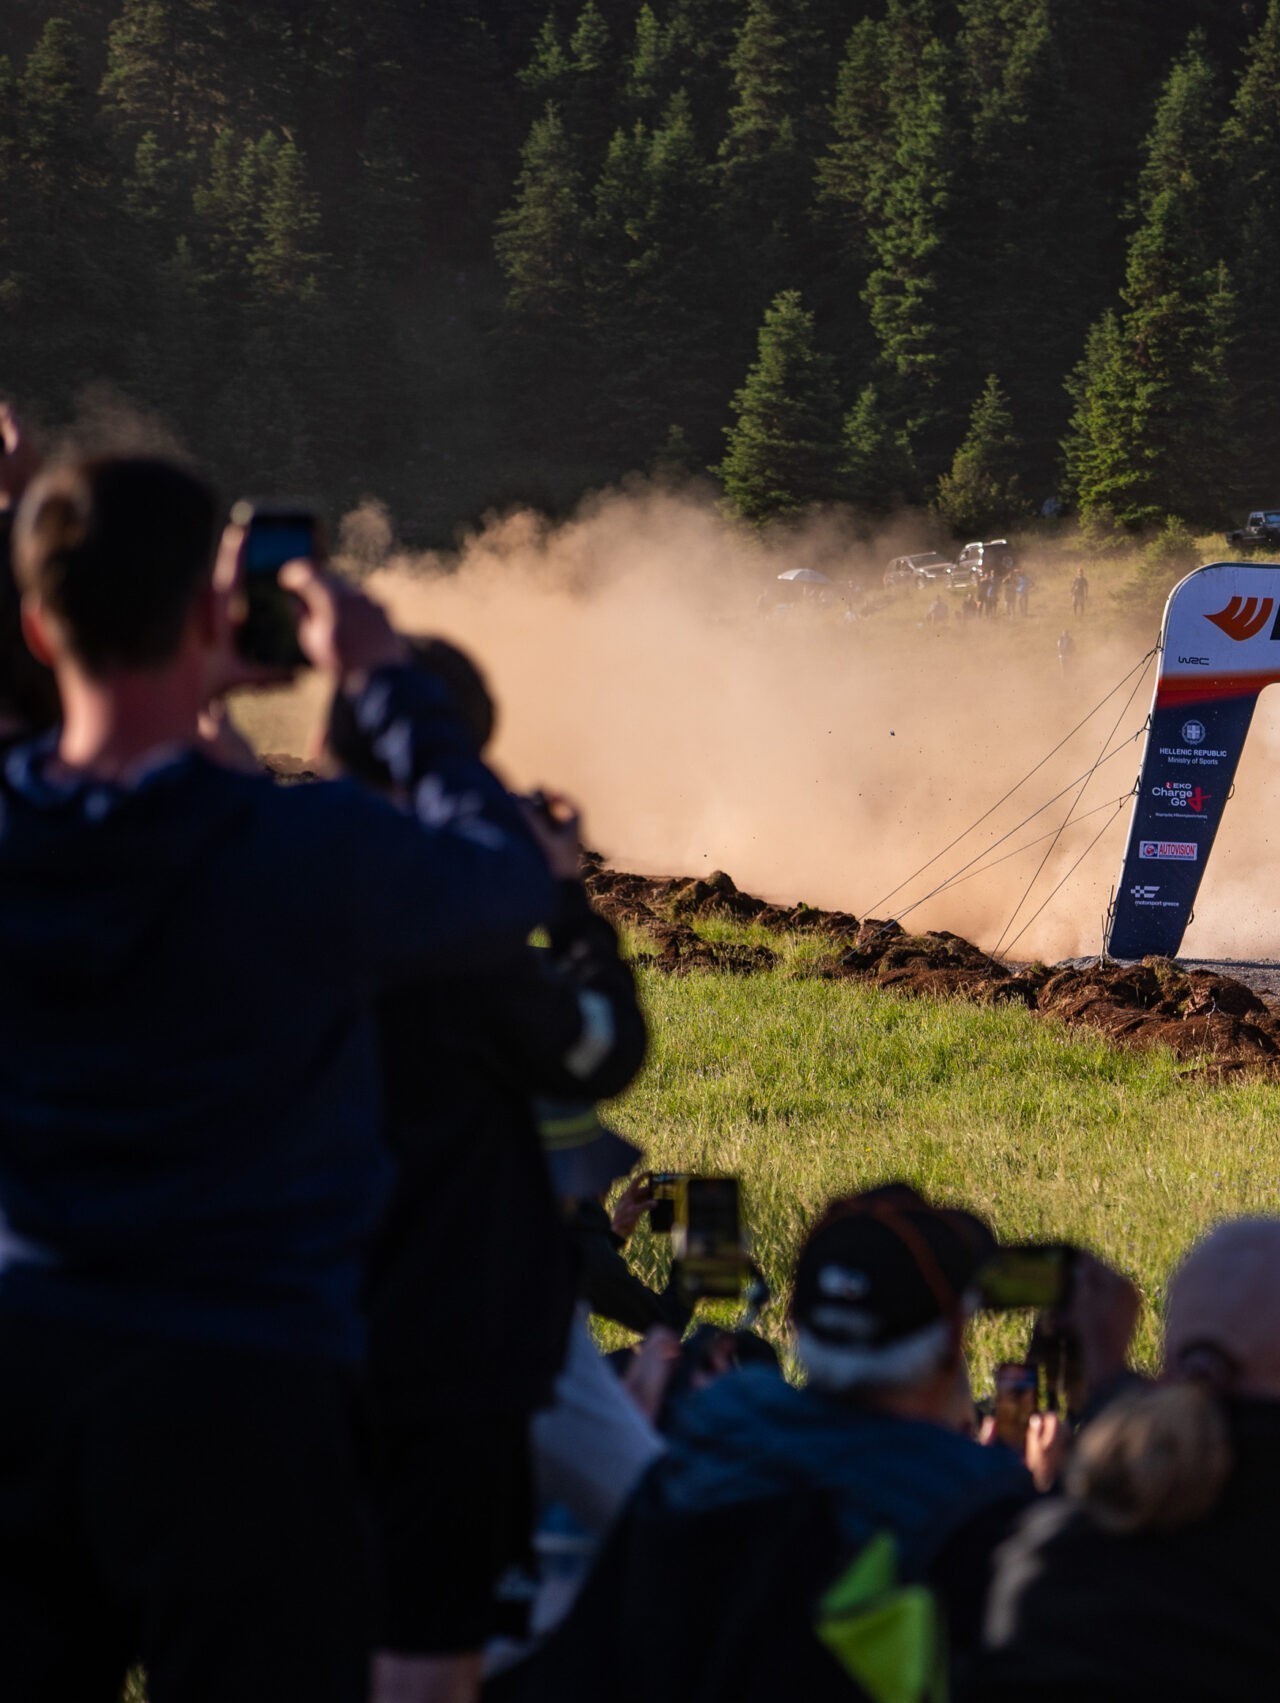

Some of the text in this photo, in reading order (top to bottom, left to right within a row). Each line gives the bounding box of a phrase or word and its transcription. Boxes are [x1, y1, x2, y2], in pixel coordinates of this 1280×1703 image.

[1160, 748, 1192, 756] HELLENIC
[1168, 757, 1190, 765] Ministry
[1199, 758, 1218, 766] Sports
[1152, 787, 1193, 799] Charge
[1171, 797, 1187, 806] Go
[1159, 843, 1194, 856] AUTOVISION
